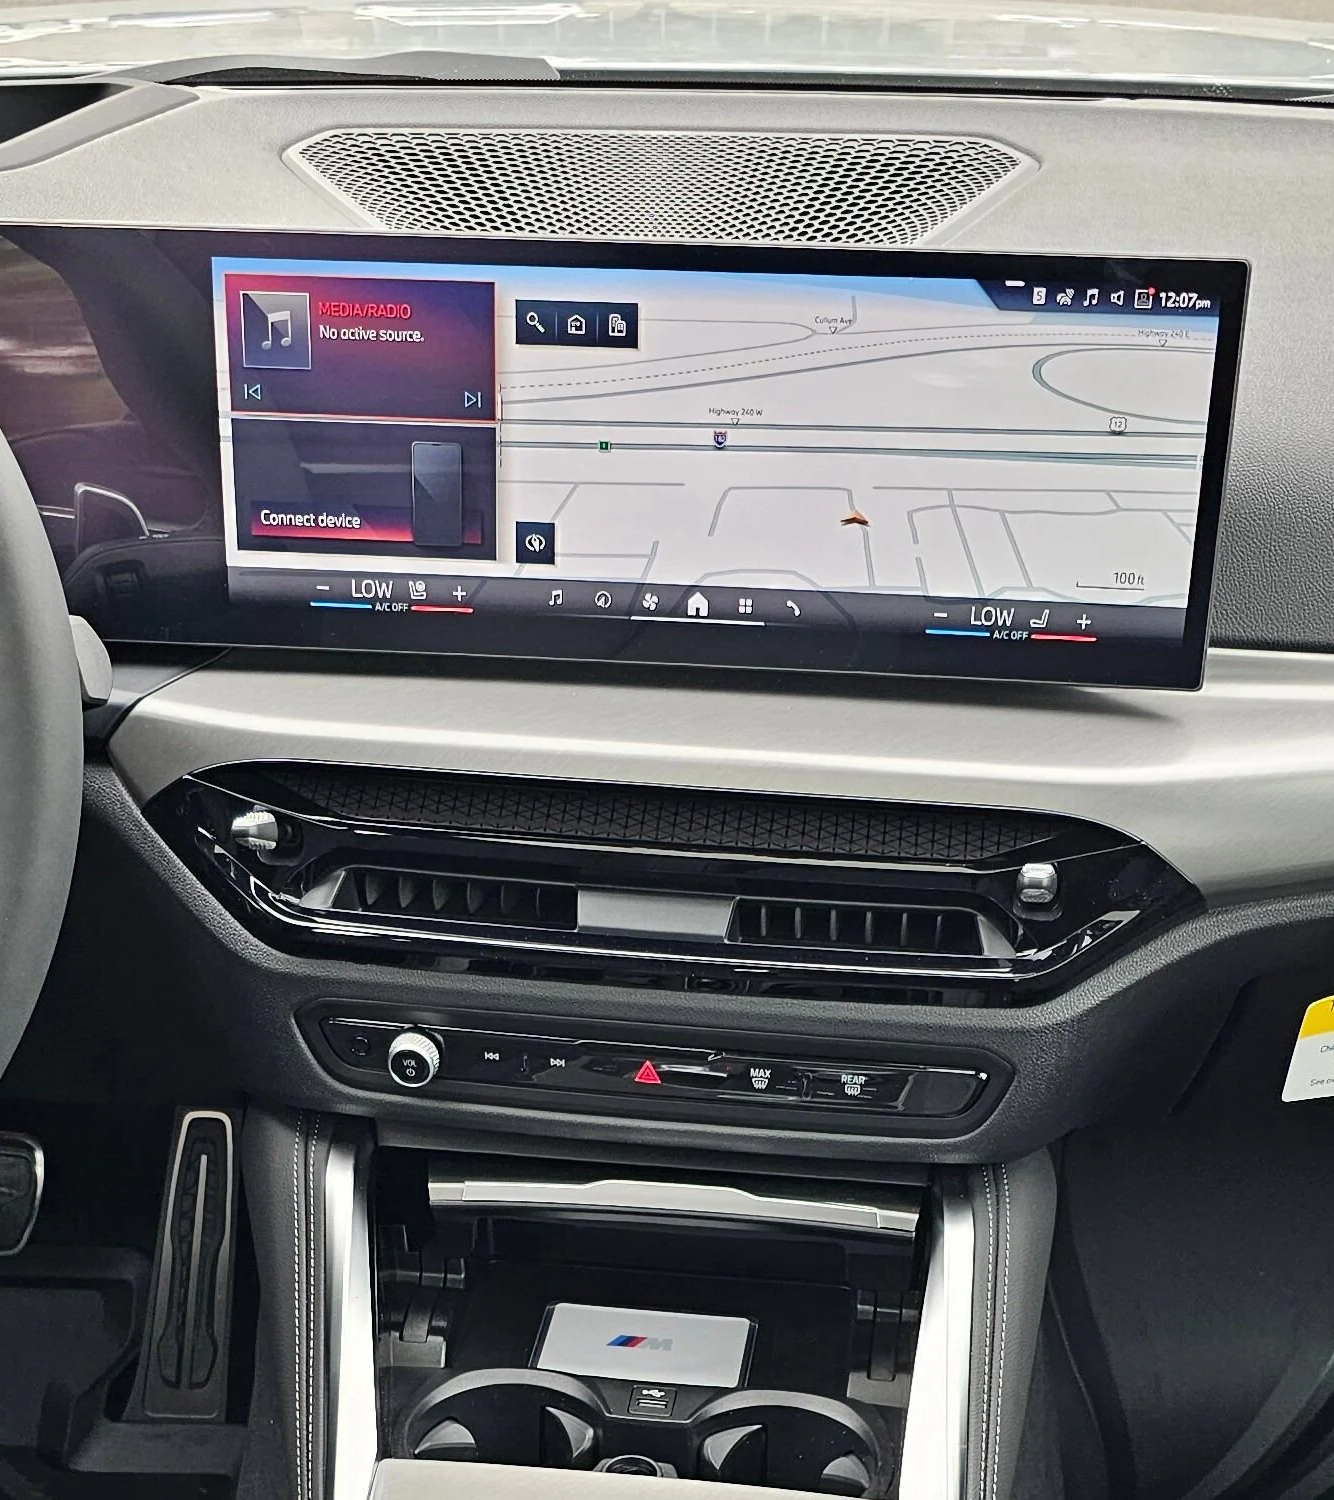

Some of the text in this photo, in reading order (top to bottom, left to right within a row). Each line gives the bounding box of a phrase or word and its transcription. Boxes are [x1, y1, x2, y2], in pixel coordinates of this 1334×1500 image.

[1159, 292, 1212, 310] 12:07pm
[318, 302, 411, 319] MEDIA/RADIO
[319, 324, 425, 342] No active source.
[708, 407, 740, 417] Highway
[260, 509, 362, 529] Connect device
[1113, 572, 1145, 586] 100 ft
[350, 578, 395, 599] LOW
[374, 602, 409, 613] A/C OFF
[969, 605, 1015, 627] LOW
[992, 630, 1029, 641] A/C OFF
[402, 1058, 418, 1068] VOL
[749, 1067, 772, 1079] MAX
[840, 1074, 866, 1085] REAR
